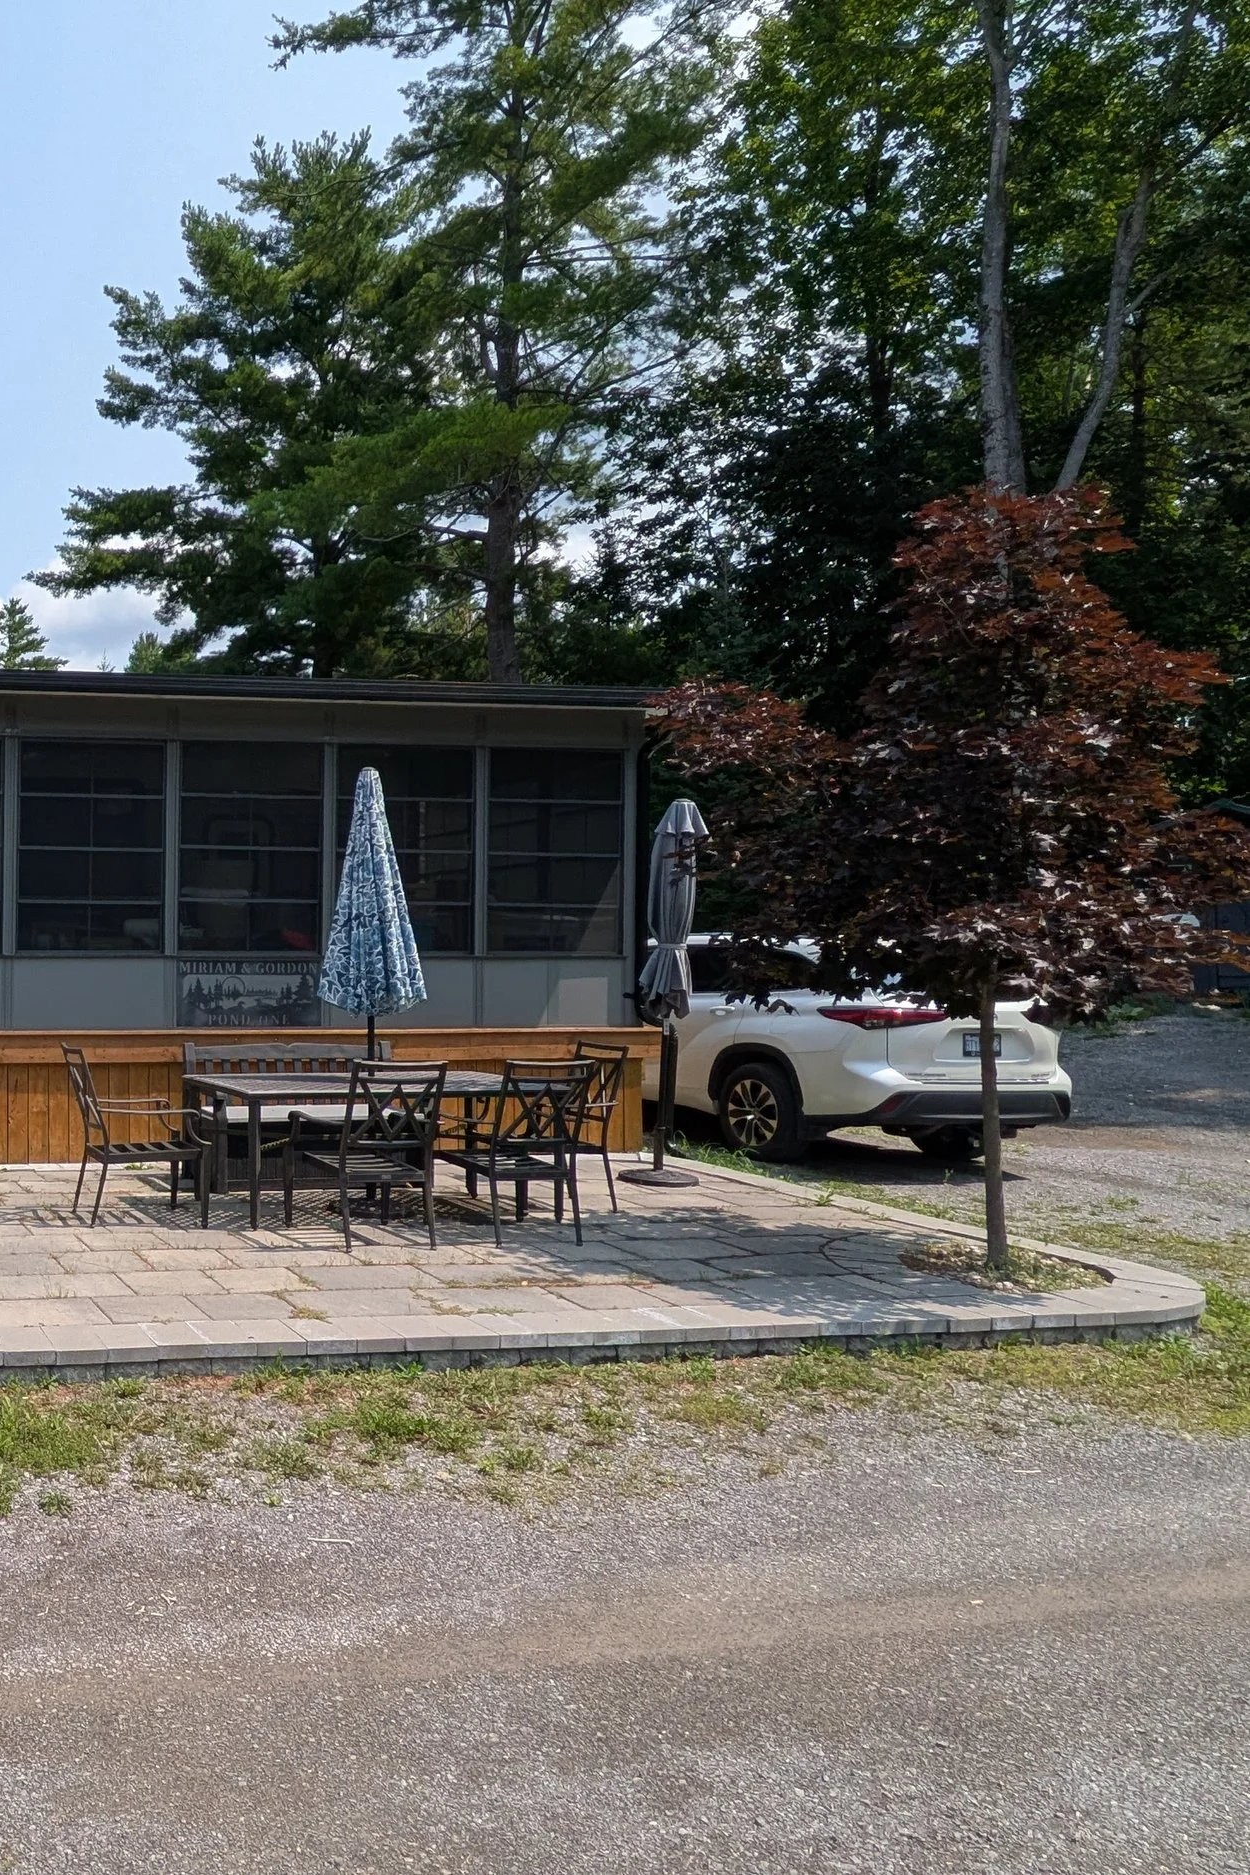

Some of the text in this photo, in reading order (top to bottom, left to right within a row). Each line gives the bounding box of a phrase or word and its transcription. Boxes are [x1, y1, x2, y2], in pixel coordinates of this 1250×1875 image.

[179, 962, 318, 974] MIRIAM & GORDON
[207, 1014, 251, 1025] POND
